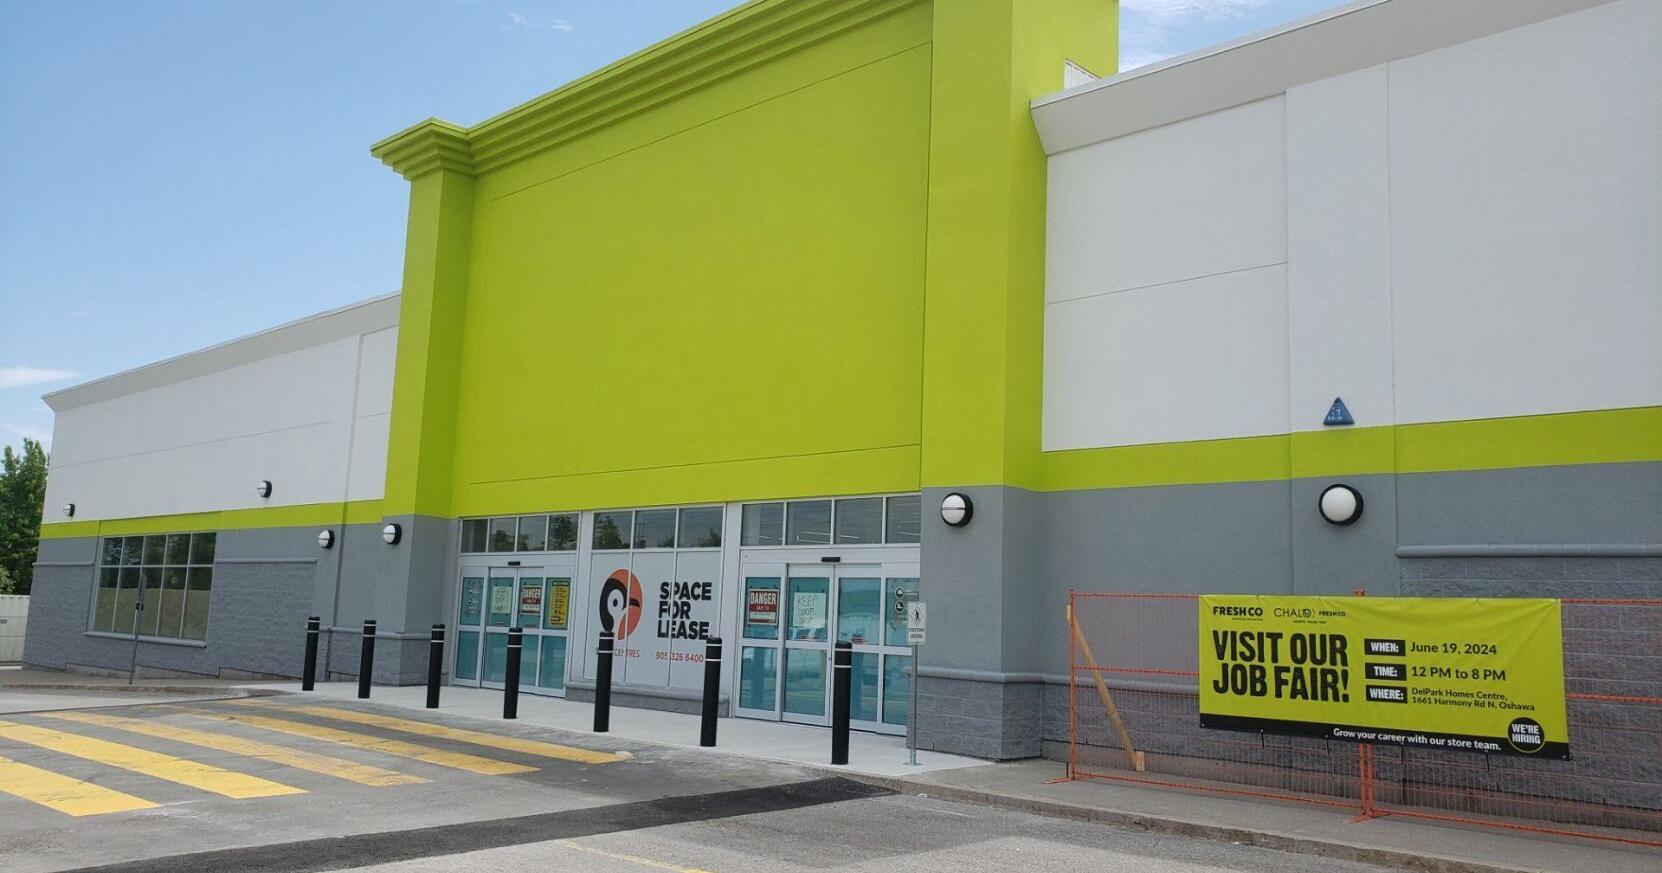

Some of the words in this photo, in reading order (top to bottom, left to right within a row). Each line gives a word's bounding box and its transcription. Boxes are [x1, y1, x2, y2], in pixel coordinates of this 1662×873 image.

[660, 582, 712, 600] SPACE
[750, 592, 776, 604] DANGER
[659, 601, 691, 619] FOR
[656, 651, 668, 660] 905
[1212, 630, 1283, 663] VISIT
[1290, 633, 1348, 666] OUR
[1371, 642, 1399, 653] WHEN:
[1410, 642, 1438, 653] June
[1442, 643, 1461, 655] 19,
[1464, 644, 1497, 655] 2024
[1373, 666, 1398, 677] TIME:
[1411, 666, 1426, 677] 12
[1430, 667, 1451, 678] PM
[1455, 669, 1468, 680] to
[1471, 669, 1480, 680] 8
[1483, 670, 1506, 681] PM
[1213, 663, 1268, 697] JOB
[1274, 666, 1350, 703] FAIR!
[1369, 688, 1404, 700] WHERE:
[1411, 687, 1444, 697] DelPark
[1445, 689, 1474, 699] Homes
[1476, 691, 1508, 701] Centre,
[1412, 696, 1432, 705] 1661
[1434, 699, 1472, 709] Harmony
[1474, 699, 1486, 708] Rd
[1499, 701, 1535, 711] Oshawa
[1511, 723, 1540, 735] WE'RE
[1333, 728, 1356, 738] Grow
[1356, 730, 1376, 740] your
[1378, 733, 1405, 743] career
[1407, 735, 1428, 745] with
[1429, 738, 1446, 746] our
[1447, 739, 1472, 749] store
[1474, 740, 1502, 751] team.
[1512, 734, 1541, 745] HIRING
